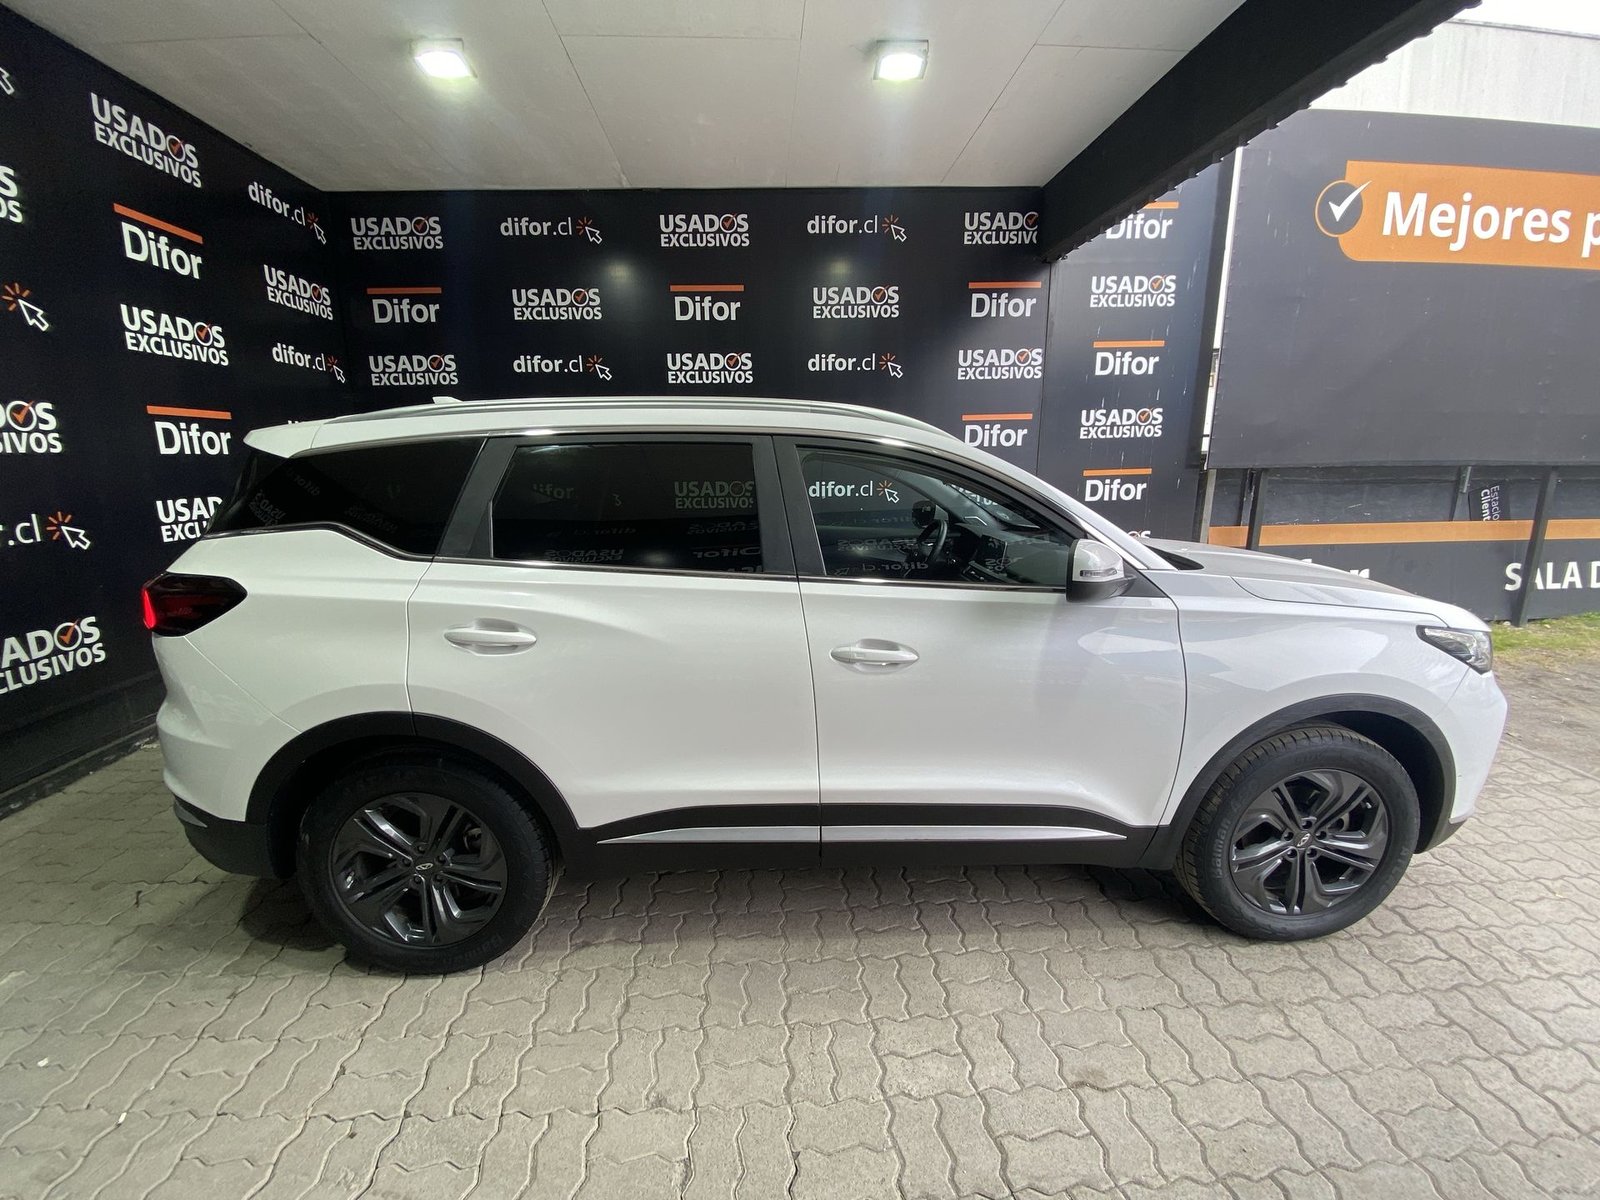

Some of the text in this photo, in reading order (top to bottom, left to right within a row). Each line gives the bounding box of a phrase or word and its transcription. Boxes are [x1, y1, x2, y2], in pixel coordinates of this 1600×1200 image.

[90, 92, 199, 169] USADOS
[94, 121, 202, 188] EXCLUSIVOS
[248, 181, 306, 226] difor.cl
[350, 216, 442, 236] USADOS
[500, 217, 573, 236] difor.cl
[659, 213, 749, 233] USADOS
[807, 215, 878, 234] difor.cl
[964, 212, 1038, 230] USADO
[1382, 191, 1572, 252] Mejores
[353, 236, 444, 250] EXCLUSIVOS
[660, 233, 750, 247] EXCLUSIVOS
[963, 231, 1037, 245] EXCLUSIV
[120, 222, 202, 279] Difor
[263, 264, 331, 306] USADOS
[1091, 275, 1177, 294] USADOS
[267, 285, 334, 321] EXCLUSIVOS
[511, 288, 601, 307] USADOS
[813, 286, 899, 305] USADOS
[970, 293, 1036, 318] Difor
[1089, 294, 1176, 308] EXCLUSIVOS
[372, 299, 440, 324] Difor
[513, 307, 602, 320] EXCLUSIVOS
[674, 296, 740, 321] Difor
[813, 305, 899, 319] EXCLUSIVOS
[120, 303, 225, 348] USADOS
[124, 332, 229, 366] EXCLUSIVOS
[272, 342, 326, 371] difor.cl
[958, 349, 1043, 367] USADOS
[368, 354, 457, 373] USADOS
[513, 355, 583, 373] difor.cl
[666, 353, 752, 371] USADOS
[807, 353, 876, 371] difor.cl
[1094, 351, 1160, 376] Difor
[371, 372, 458, 386] EXCLUSIVOS
[668, 371, 753, 384] EXCLUSIVOS
[957, 366, 1043, 380] EXCLUSIVOS
[1081, 407, 1164, 426] USADOS
[154, 421, 231, 455] Difor
[964, 424, 1028, 448] Difor
[1079, 425, 1163, 439] EXCLUSIVOS
[1084, 479, 1147, 502] Difor
[156, 497, 222, 523] USAD
[1481, 489, 1492, 521] Client
[1490, 485, 1501, 520] Estacio
[1, 616, 101, 668] ADOS
